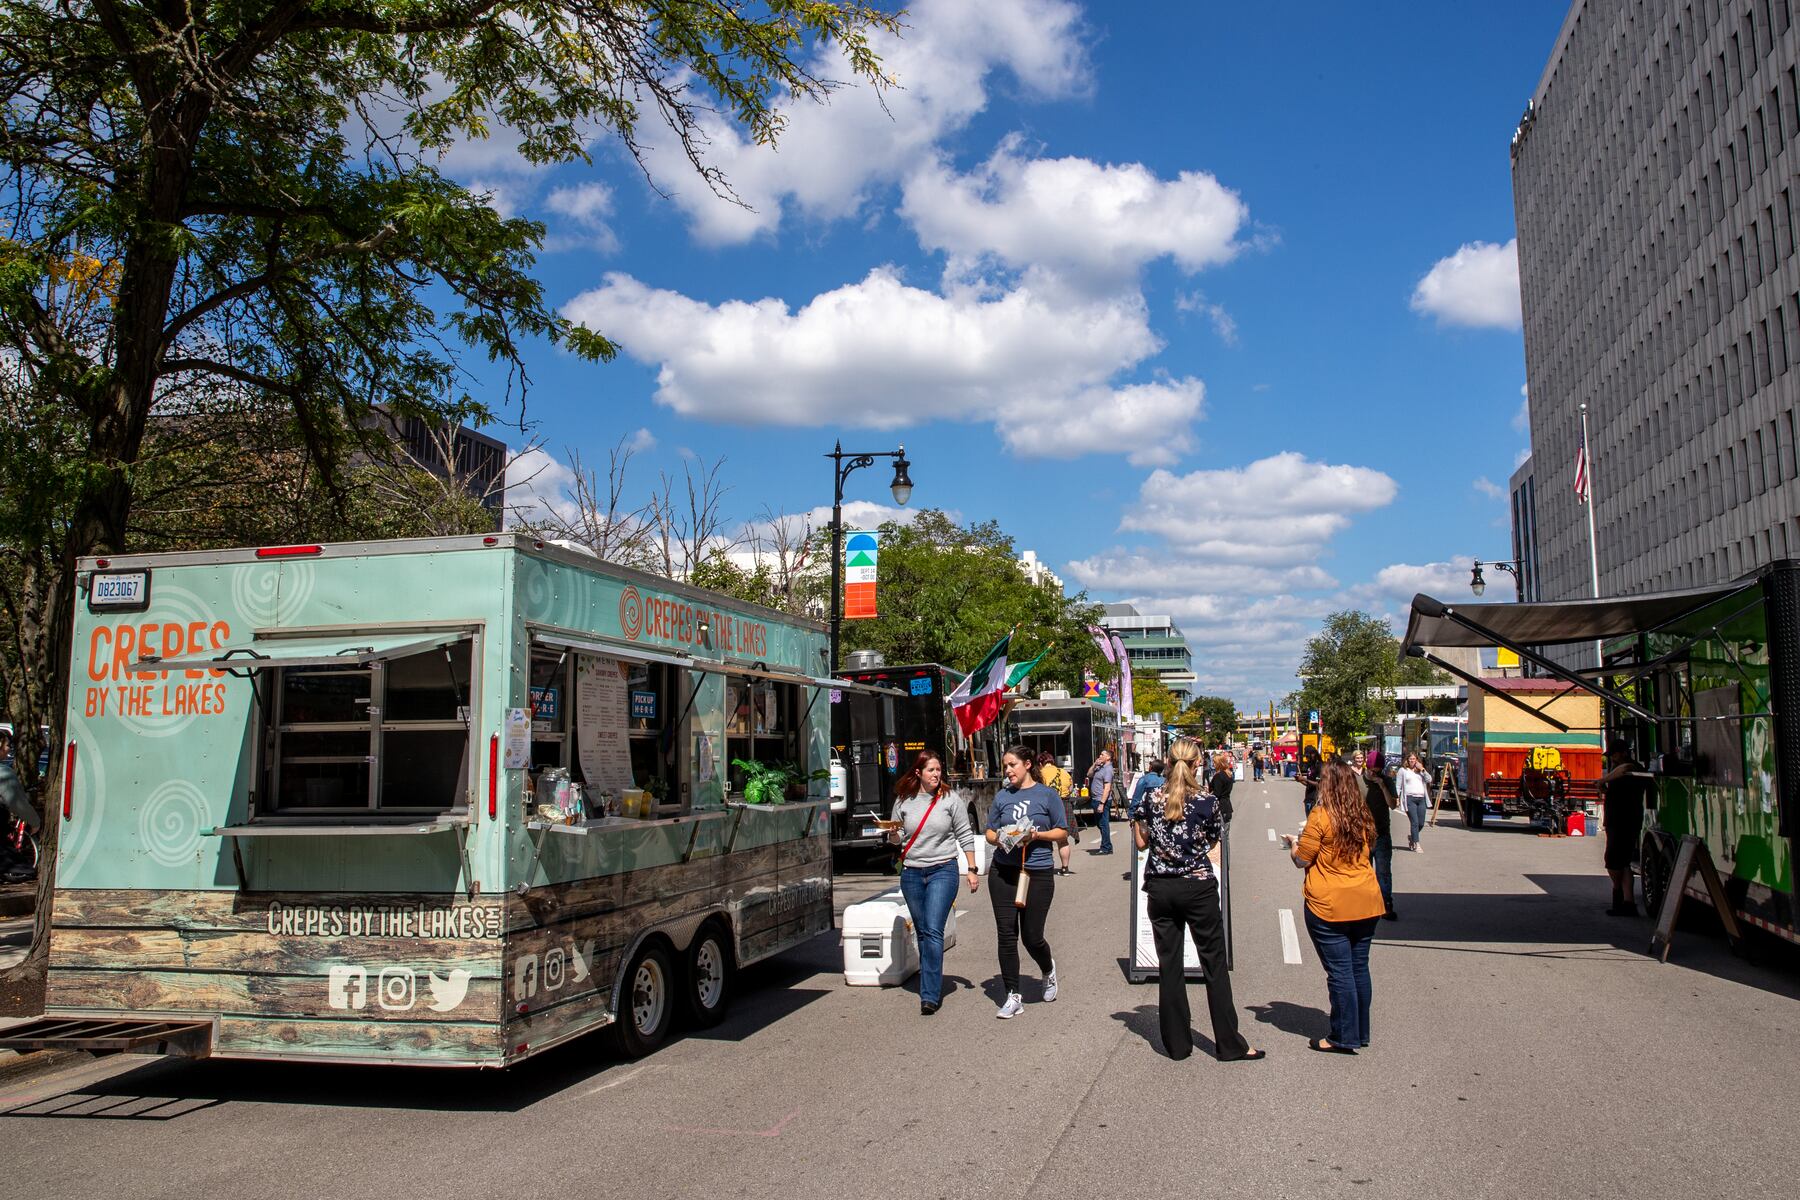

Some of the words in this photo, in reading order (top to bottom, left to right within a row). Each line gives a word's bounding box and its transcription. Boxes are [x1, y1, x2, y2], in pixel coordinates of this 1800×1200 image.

[97, 581, 139, 597] D823067
[645, 596, 693, 644] CREPES
[696, 607, 711, 647] BY
[713, 612, 733, 651] THE
[736, 617, 767, 657] LAKES
[87, 620, 231, 682] CREPES
[85, 687, 109, 718] BY
[117, 685, 155, 716] THE
[162, 683, 226, 716] LAKES
[267, 901, 344, 937] CREPES
